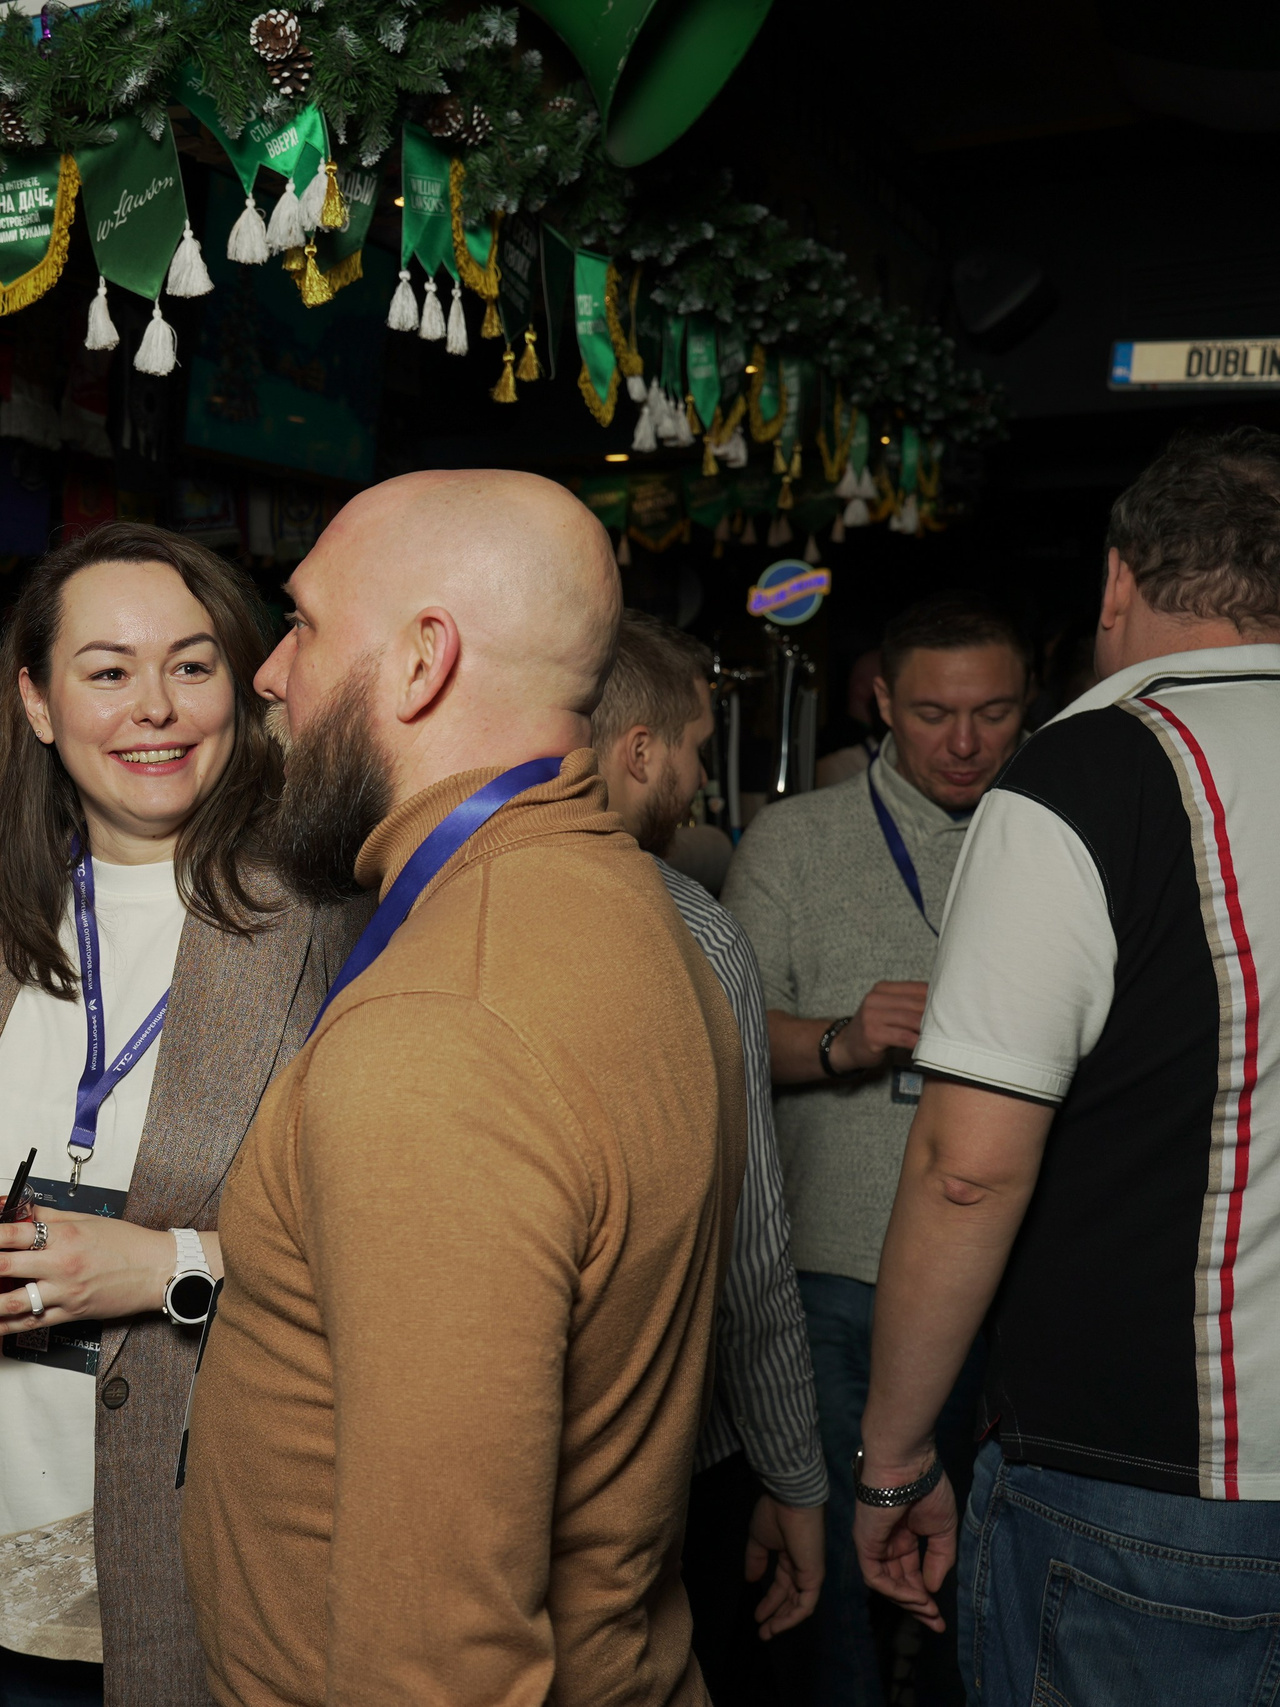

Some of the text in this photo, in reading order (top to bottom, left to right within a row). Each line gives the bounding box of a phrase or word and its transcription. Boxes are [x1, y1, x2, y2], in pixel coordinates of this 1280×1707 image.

[18, 187, 53, 214] ДАЧЕ,
[19, 223, 51, 240] РУКАМИ
[1186, 346, 1280, 377] DUBLIN
[77, 857, 86, 877] ТС
[132, 1007, 167, 1051] КОНФЕРЕНЦИЯ
[90, 1043, 98, 1071] ТЕЛЕКОМ
[33, 1191, 43, 1200] ТС
